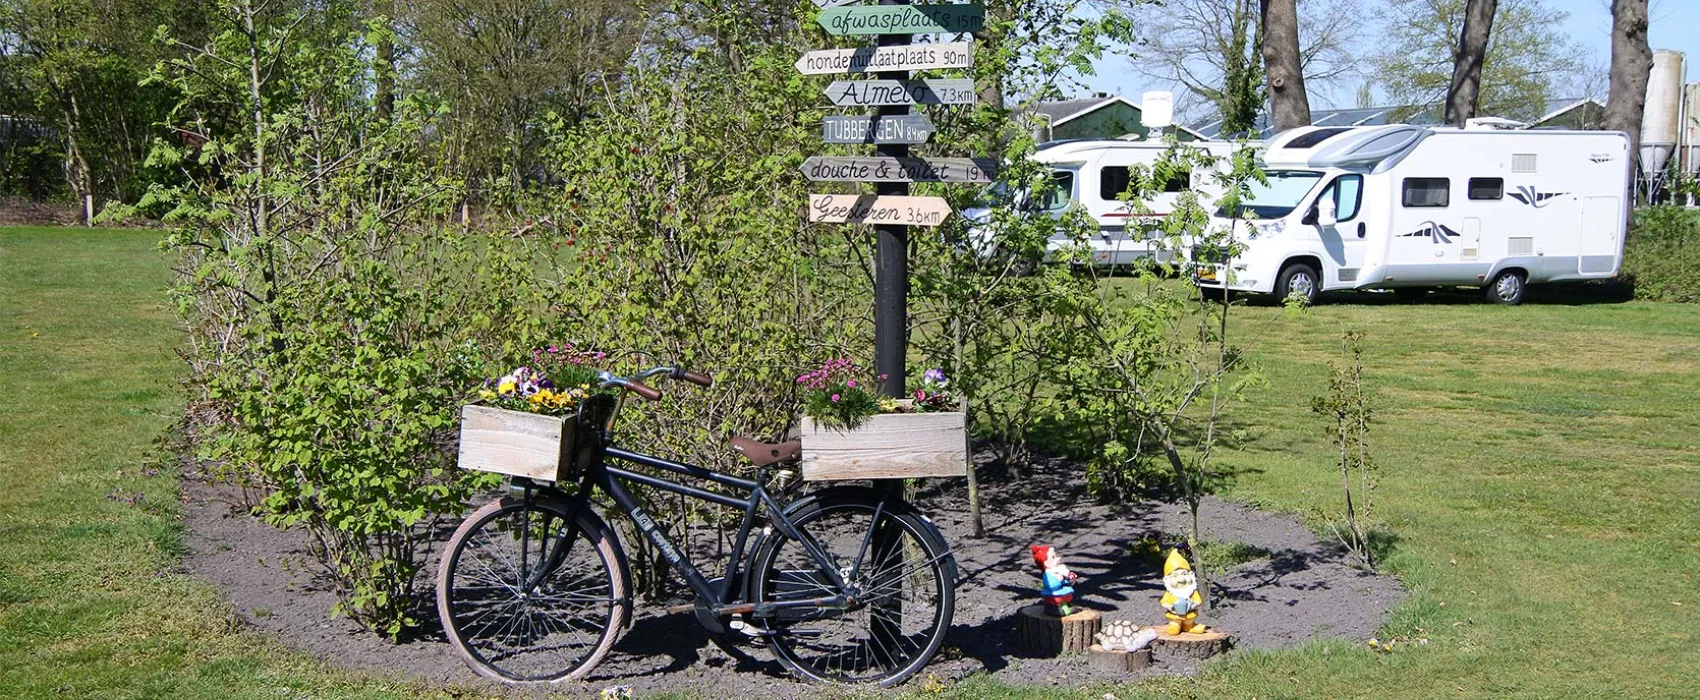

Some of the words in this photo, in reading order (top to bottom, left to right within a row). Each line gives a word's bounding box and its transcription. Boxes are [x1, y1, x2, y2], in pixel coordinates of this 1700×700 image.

[832, 8, 950, 34] afwasplaats
[807, 47, 936, 70] hondenuitlaatplaats
[837, 82, 930, 104] Almelo
[826, 119, 904, 140] TUBBERGEN
[810, 160, 869, 179] douche
[875, 160, 891, 179] &
[898, 161, 950, 179] toilet
[813, 195, 901, 221] Geesteren
